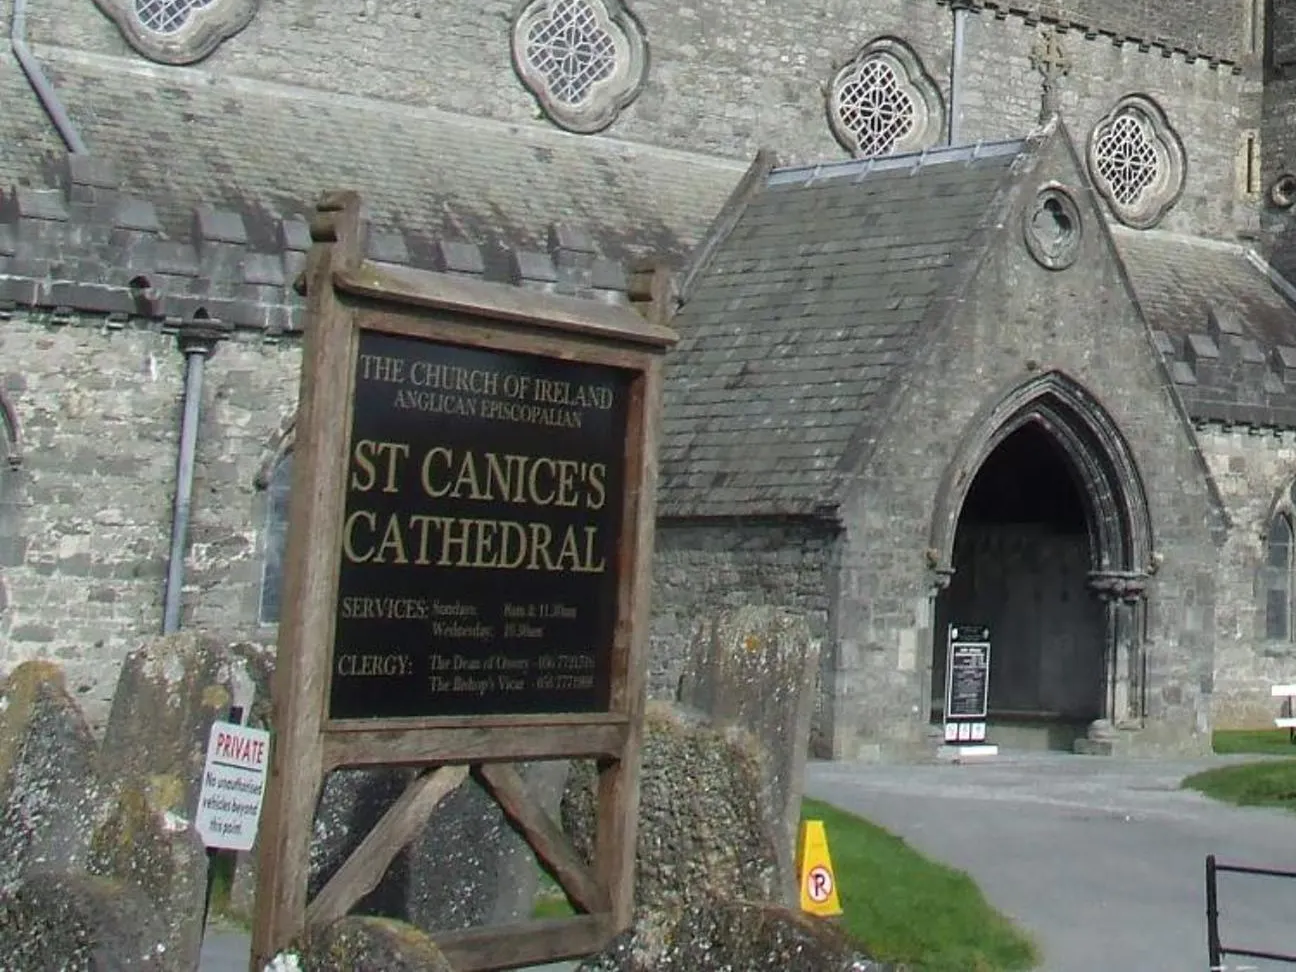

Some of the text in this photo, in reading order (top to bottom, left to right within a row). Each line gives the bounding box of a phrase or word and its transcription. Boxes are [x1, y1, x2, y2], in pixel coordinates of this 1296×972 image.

[361, 354, 613, 410] THE CHURCH OF IRELAND
[394, 389, 582, 429] ANGLICAN EPISCOPALIAN
[352, 439, 606, 510] ST CANICE'S
[343, 510, 605, 573] CATHEDRAL
[342, 596, 429, 619] SERVICES:
[338, 654, 413, 676] CLERGY:
[428, 654, 451, 669] The
[428, 676, 450, 692] The
[215, 733, 265, 764] PRIVATE
[206, 772, 217, 788] No
